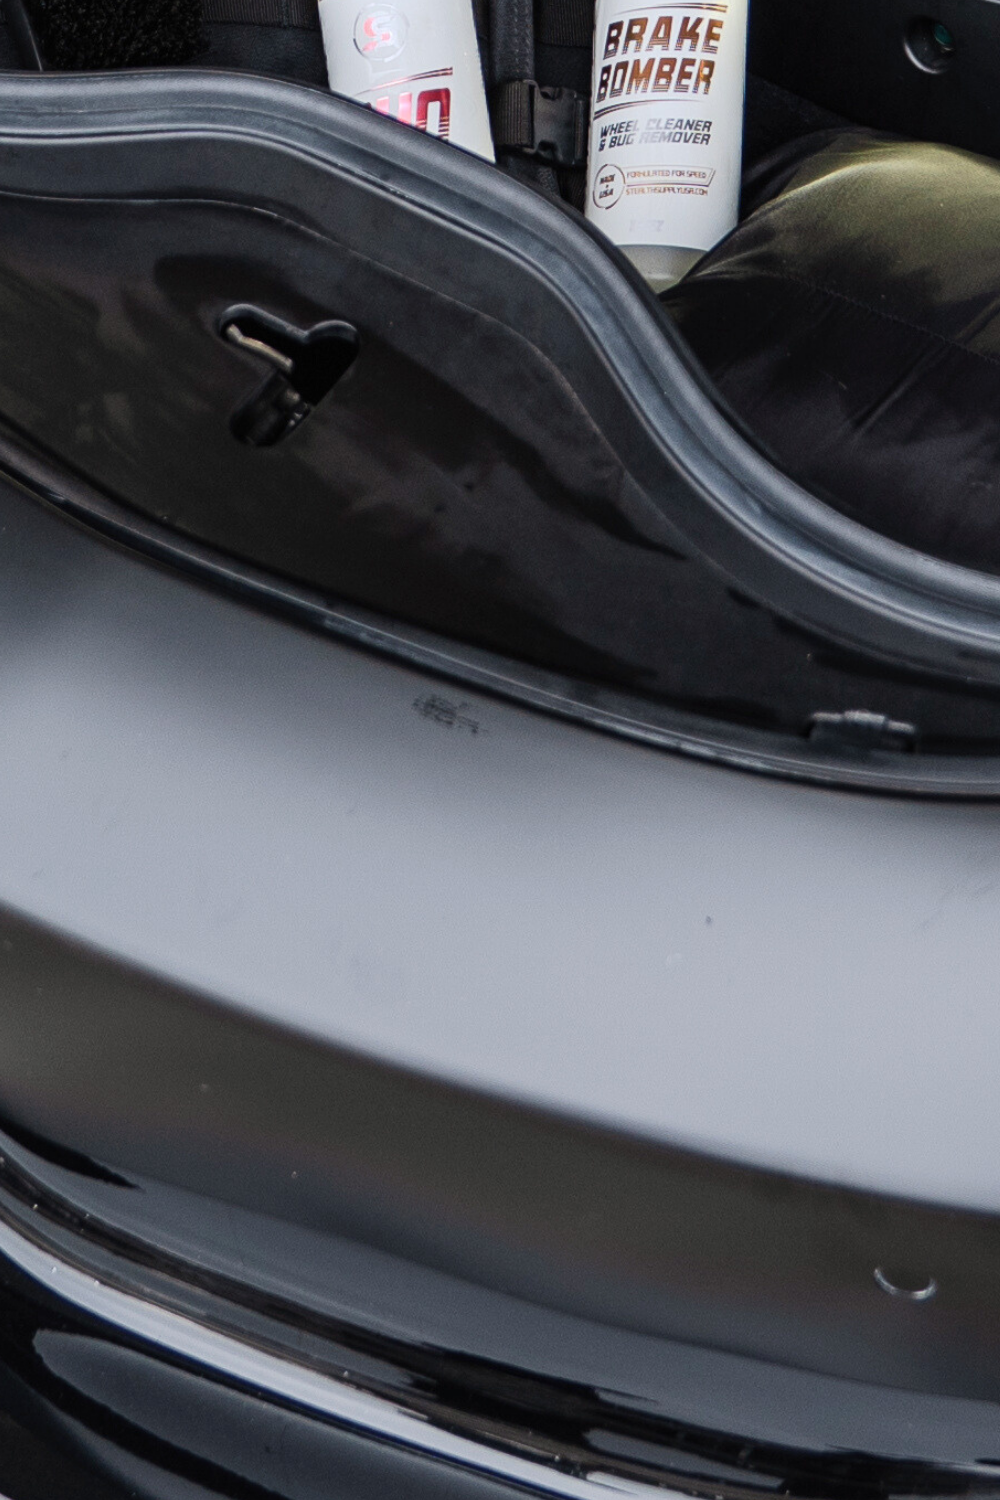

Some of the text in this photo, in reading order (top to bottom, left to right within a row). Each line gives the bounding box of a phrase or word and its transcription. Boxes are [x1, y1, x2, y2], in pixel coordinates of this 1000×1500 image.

[603, 15, 724, 60] BRAKE
[596, 57, 716, 104] BOMBER
[600, 118, 713, 139] WHEEL CLEANER
[598, 131, 711, 152] & BUG REMOVER
[671, 169, 686, 178] FOR
